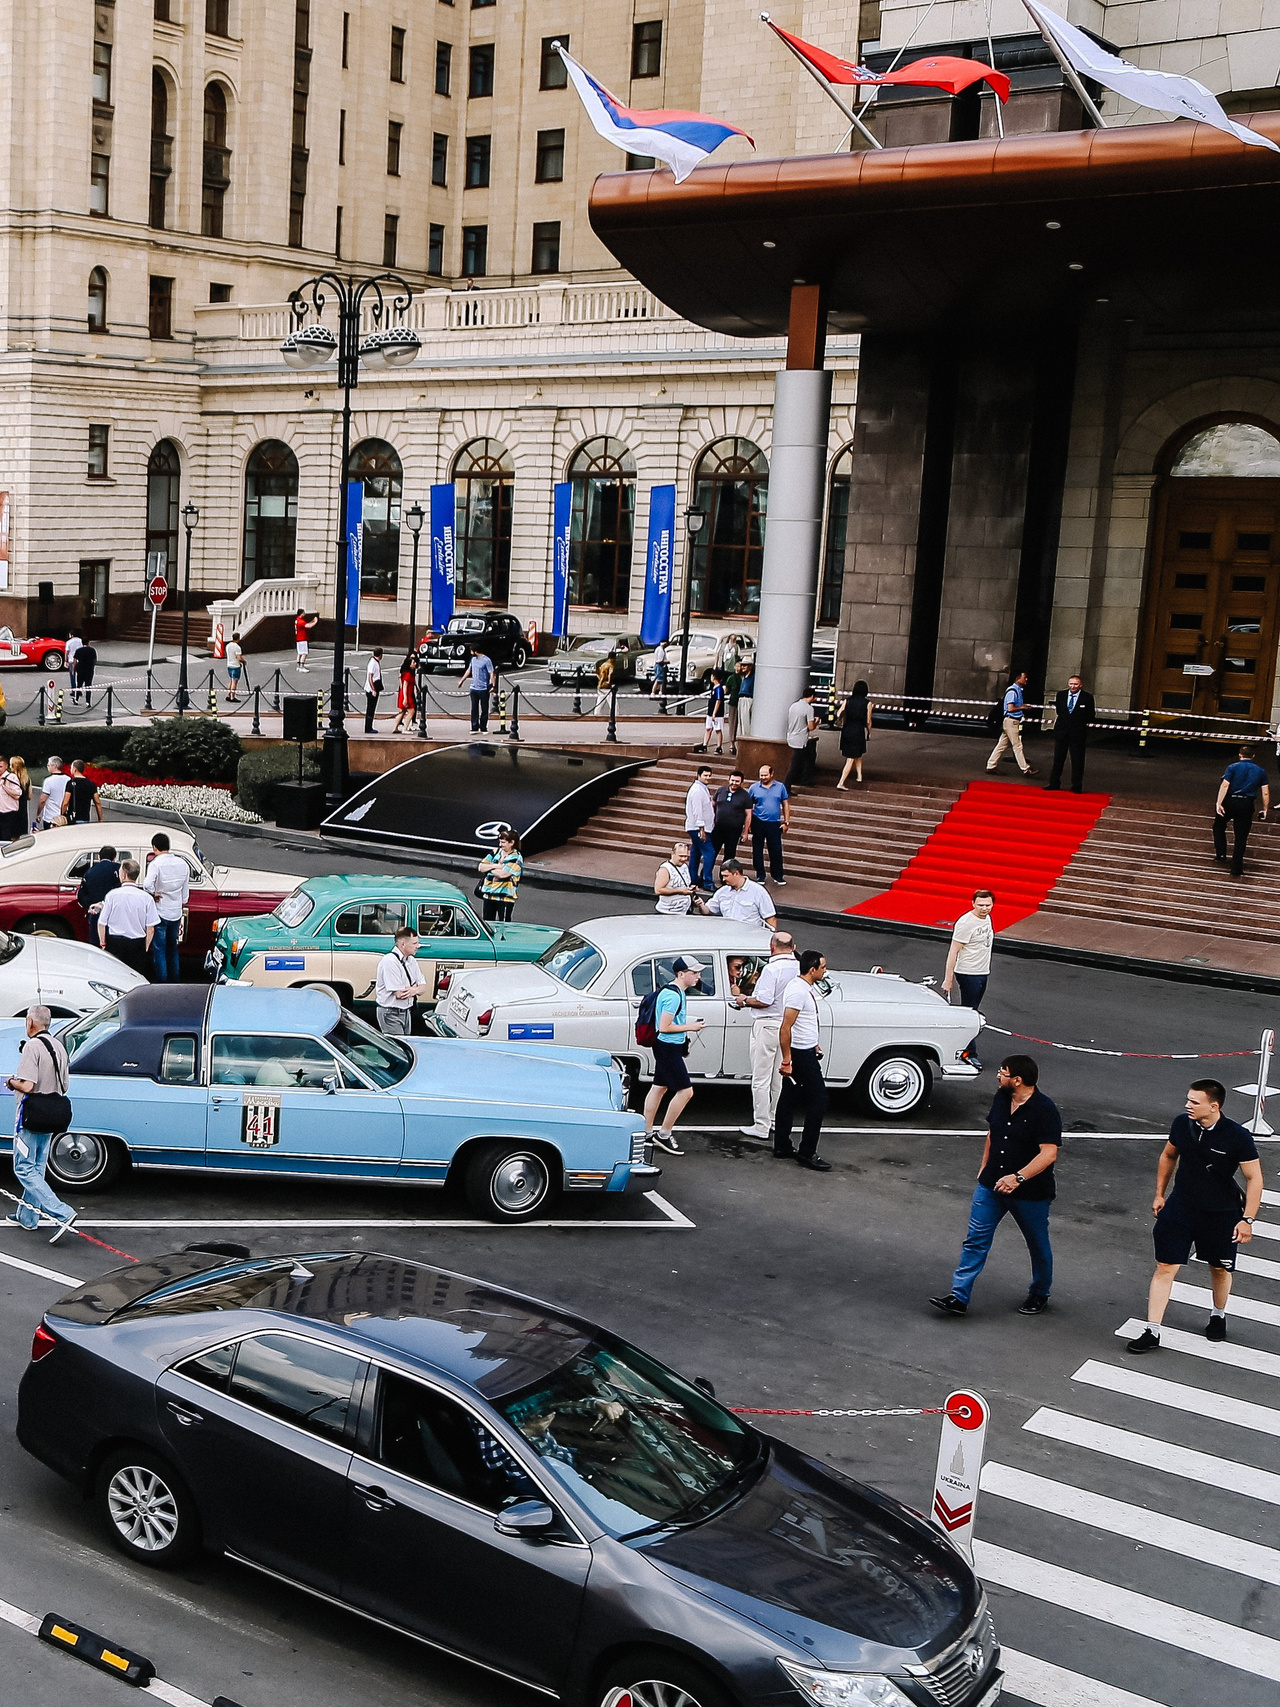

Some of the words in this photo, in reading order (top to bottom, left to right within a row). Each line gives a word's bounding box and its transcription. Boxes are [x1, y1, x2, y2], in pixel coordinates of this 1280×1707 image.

[443, 526, 455, 586] ИНГОССТРАХ
[658, 529, 670, 595] ИНГОССТРАХ
[150, 586, 167, 596] STOP
[246, 1114, 274, 1136] 41
[940, 1474, 971, 1491] UKRAINA
